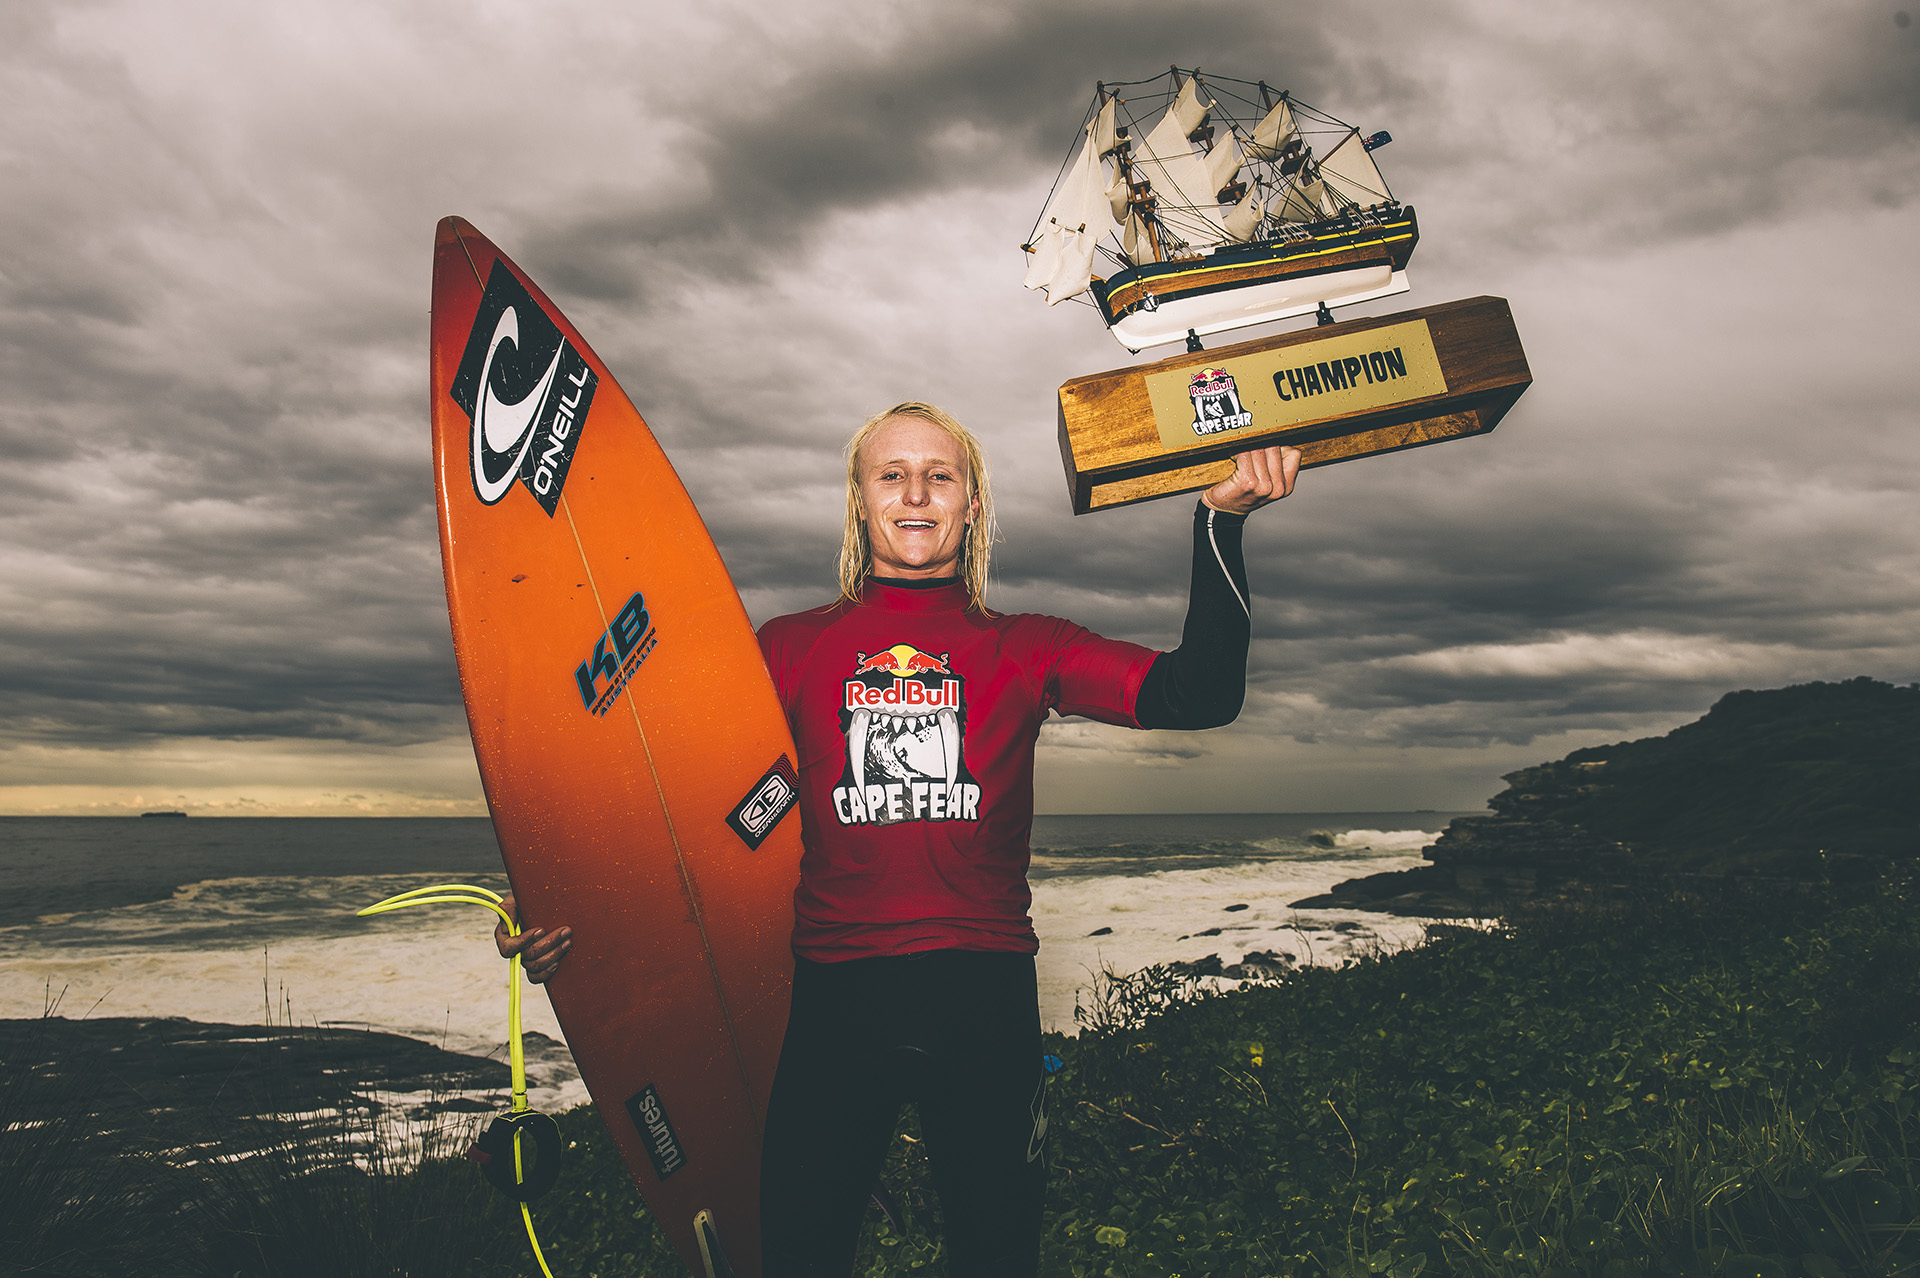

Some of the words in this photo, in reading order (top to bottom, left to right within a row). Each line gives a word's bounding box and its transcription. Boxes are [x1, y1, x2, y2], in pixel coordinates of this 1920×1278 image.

[1190, 382, 1212, 396] Red
[1212, 378, 1234, 392] Bull
[1272, 347, 1408, 402] CHAMPION
[1192, 418, 1223, 435] CAPE
[1222, 412, 1252, 431] FEAR
[574, 591, 650, 712] KB
[601, 638, 658, 719] AUSTRALIA
[614, 671, 623, 684] BY
[846, 679, 901, 706] Red
[906, 680, 957, 706] Bull
[832, 783, 903, 824] CAPE
[912, 781, 980, 821] FEAR
